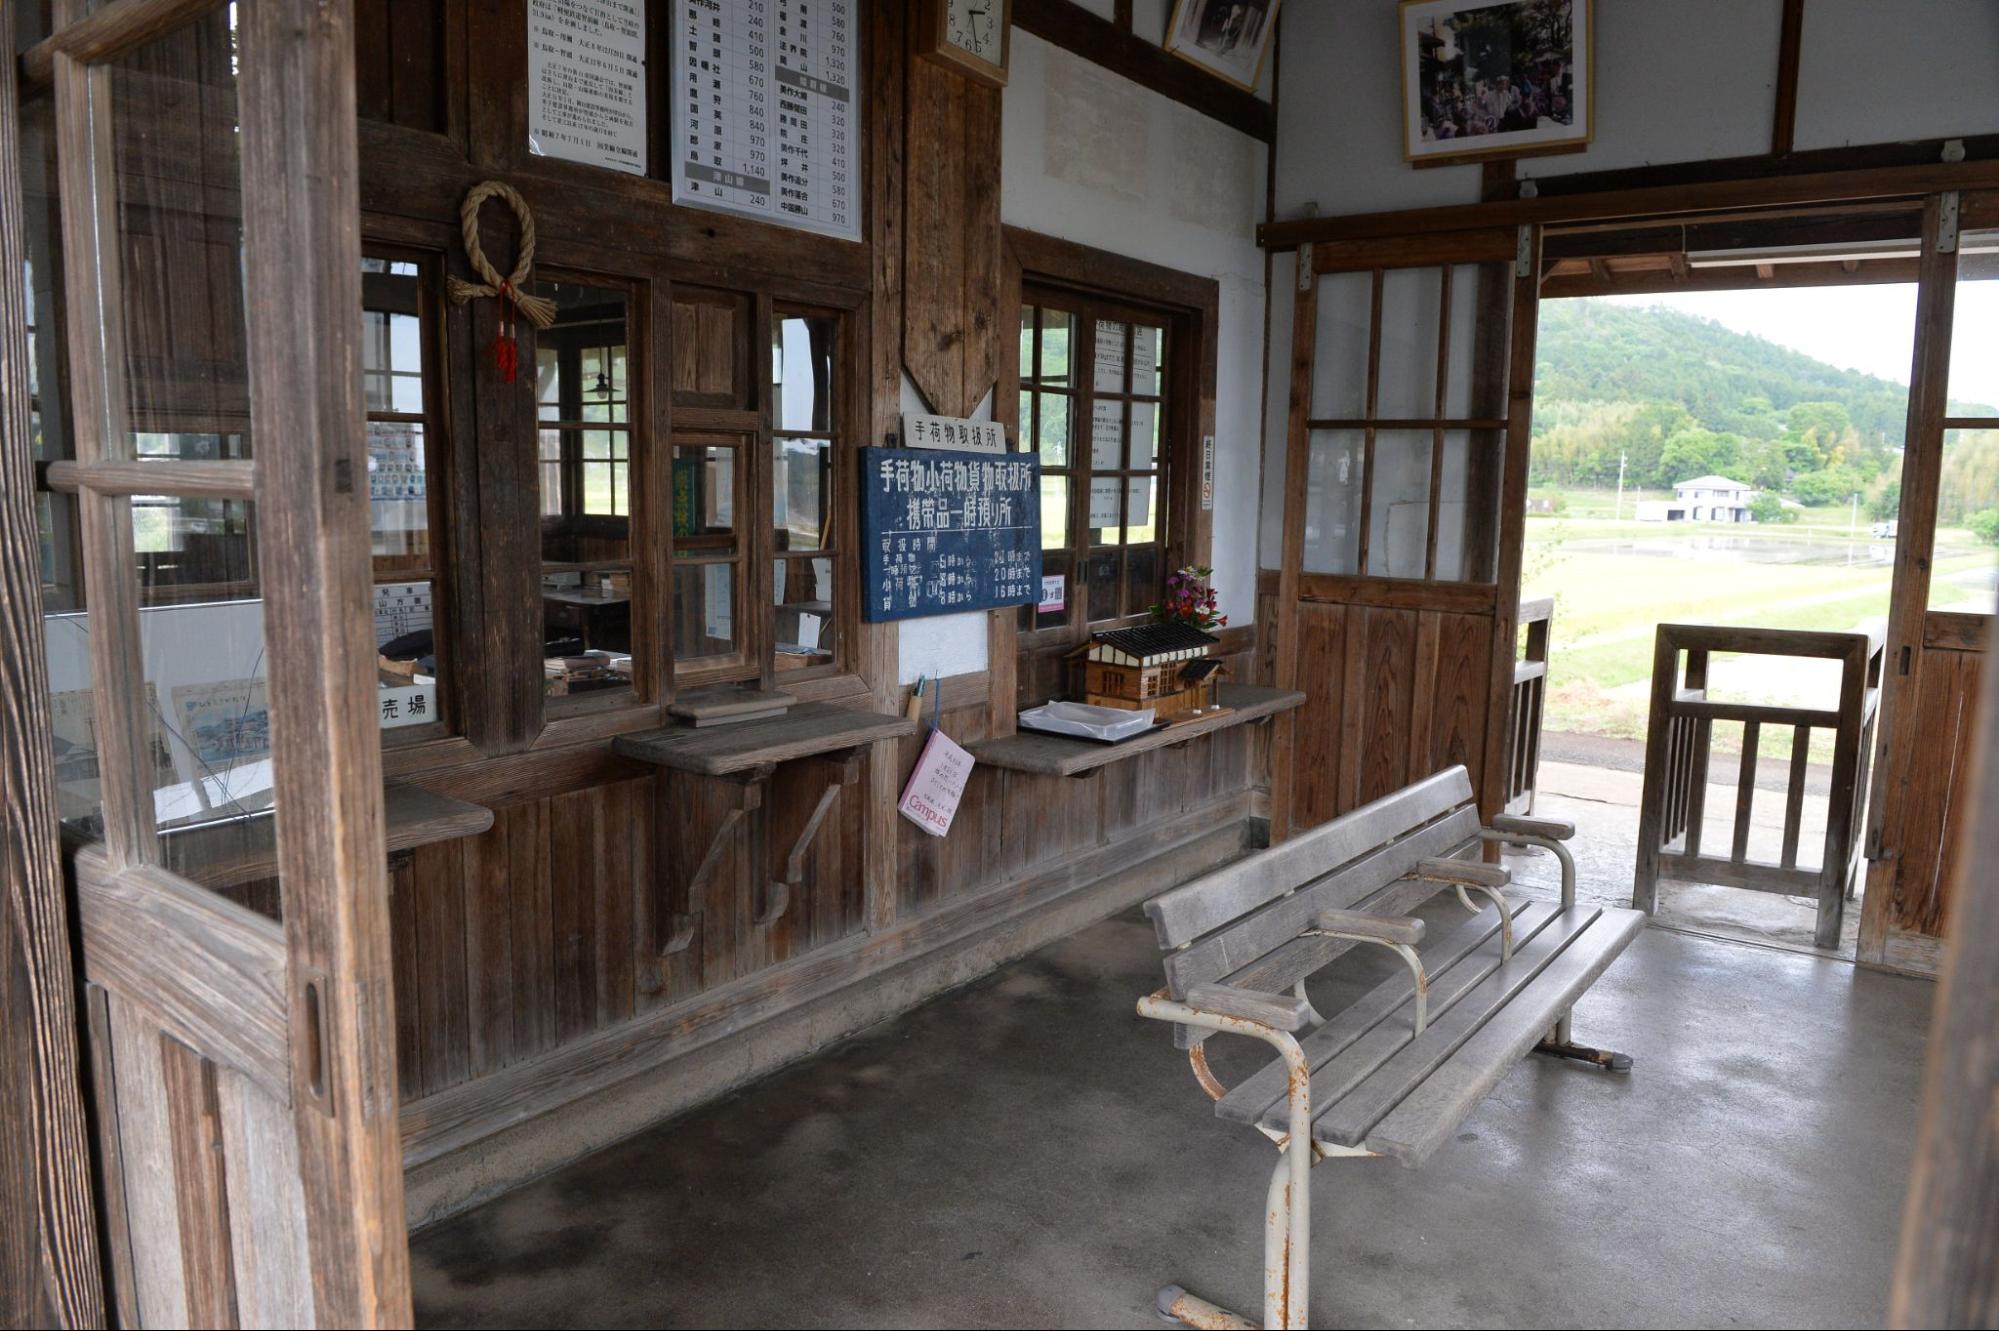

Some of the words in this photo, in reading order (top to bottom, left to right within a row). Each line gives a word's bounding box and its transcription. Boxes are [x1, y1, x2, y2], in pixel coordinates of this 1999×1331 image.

[748, 14, 764, 28] 240
[949, 14, 956, 27] 8
[986, 16, 993, 29] 3
[748, 30, 764, 43] 410
[832, 30, 845, 43] 760
[956, 30, 963, 42] 7
[983, 32, 990, 45] 4
[748, 45, 764, 58] 500
[832, 45, 845, 57] 970
[965, 39, 972, 51] 6
[748, 59, 764, 73] 580
[748, 75, 764, 88] 670
[748, 90, 764, 103] 760
[749, 104, 764, 117] 840
[749, 120, 765, 133] 840
[750, 135, 765, 147] 970
[750, 150, 765, 162] 970
[832, 157, 845, 169] 410
[743, 163, 765, 177] 1,140
[832, 171, 845, 183] 500
[750, 194, 765, 206] 240
[832, 199, 845, 211] 670
[832, 213, 845, 224] 970
[915, 421, 997, 448] 手荷物取扱所
[880, 458, 1032, 493] 手荷物小荷物貨物取扱所
[382, 694, 427, 720] 売場
[909, 794, 948, 828] Campus
